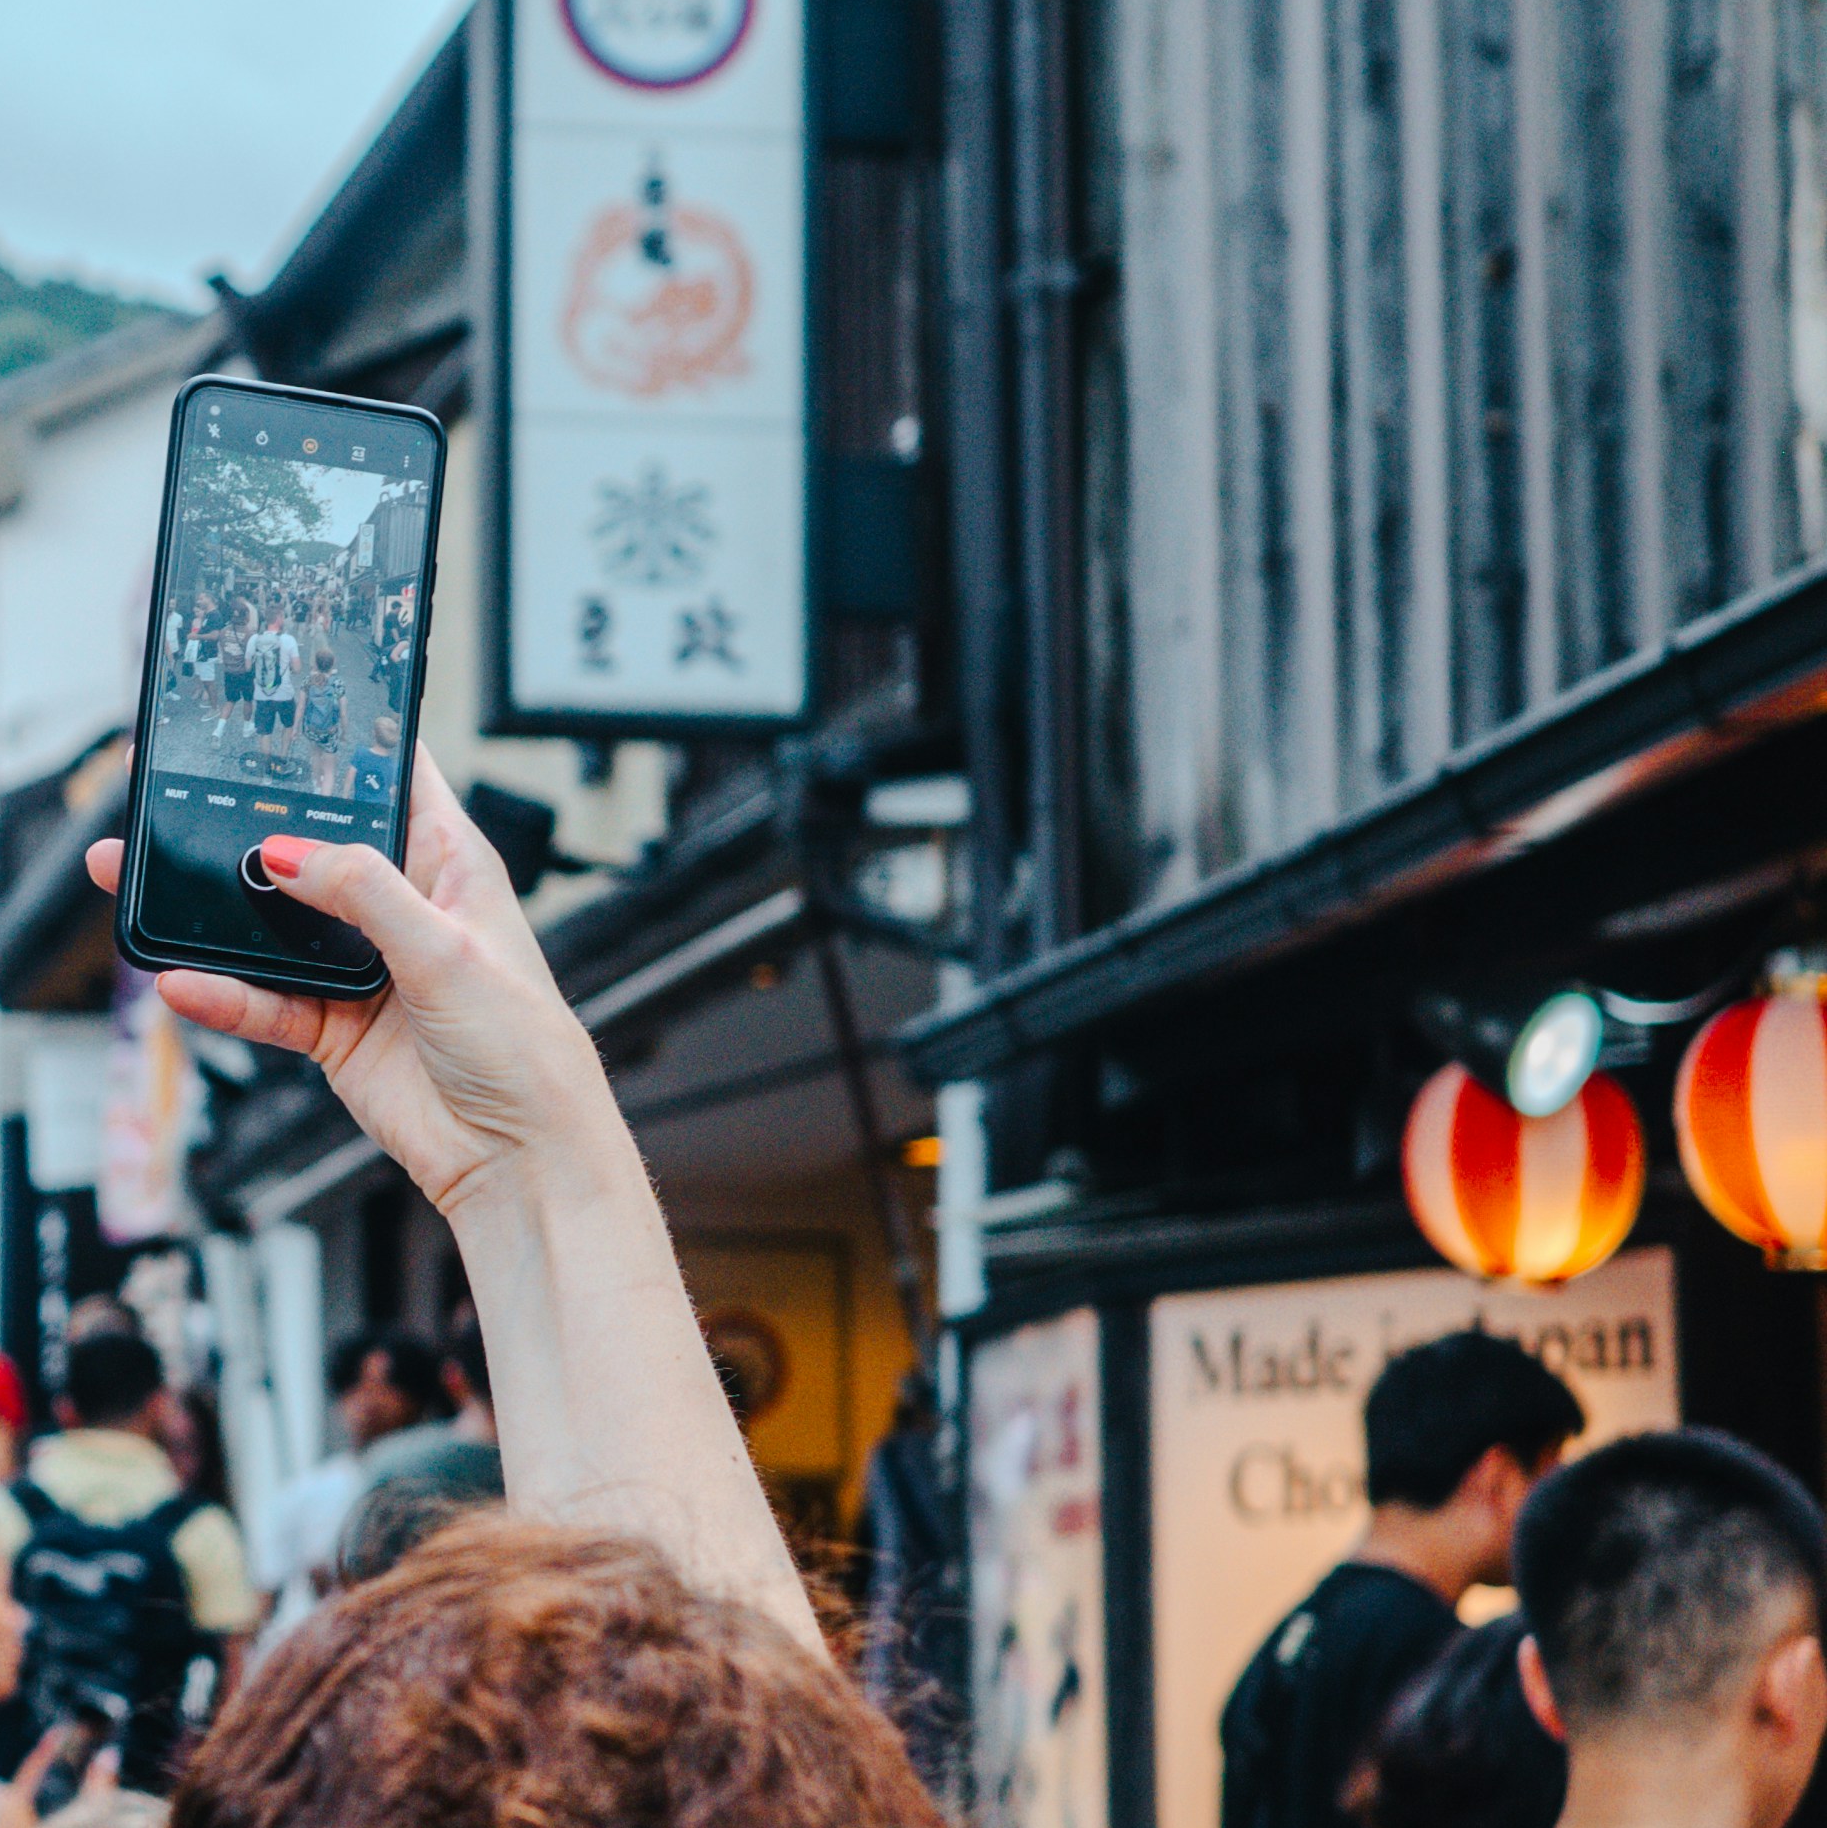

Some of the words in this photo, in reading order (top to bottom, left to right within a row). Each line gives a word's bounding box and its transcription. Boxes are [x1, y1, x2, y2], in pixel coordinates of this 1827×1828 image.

[165, 788, 189, 800] NUIT
[207, 793, 236, 807] VIDÉO
[254, 801, 288, 815] PHOTO
[306, 809, 354, 824] PORTRAIT
[1185, 1319, 1356, 1395] Made
